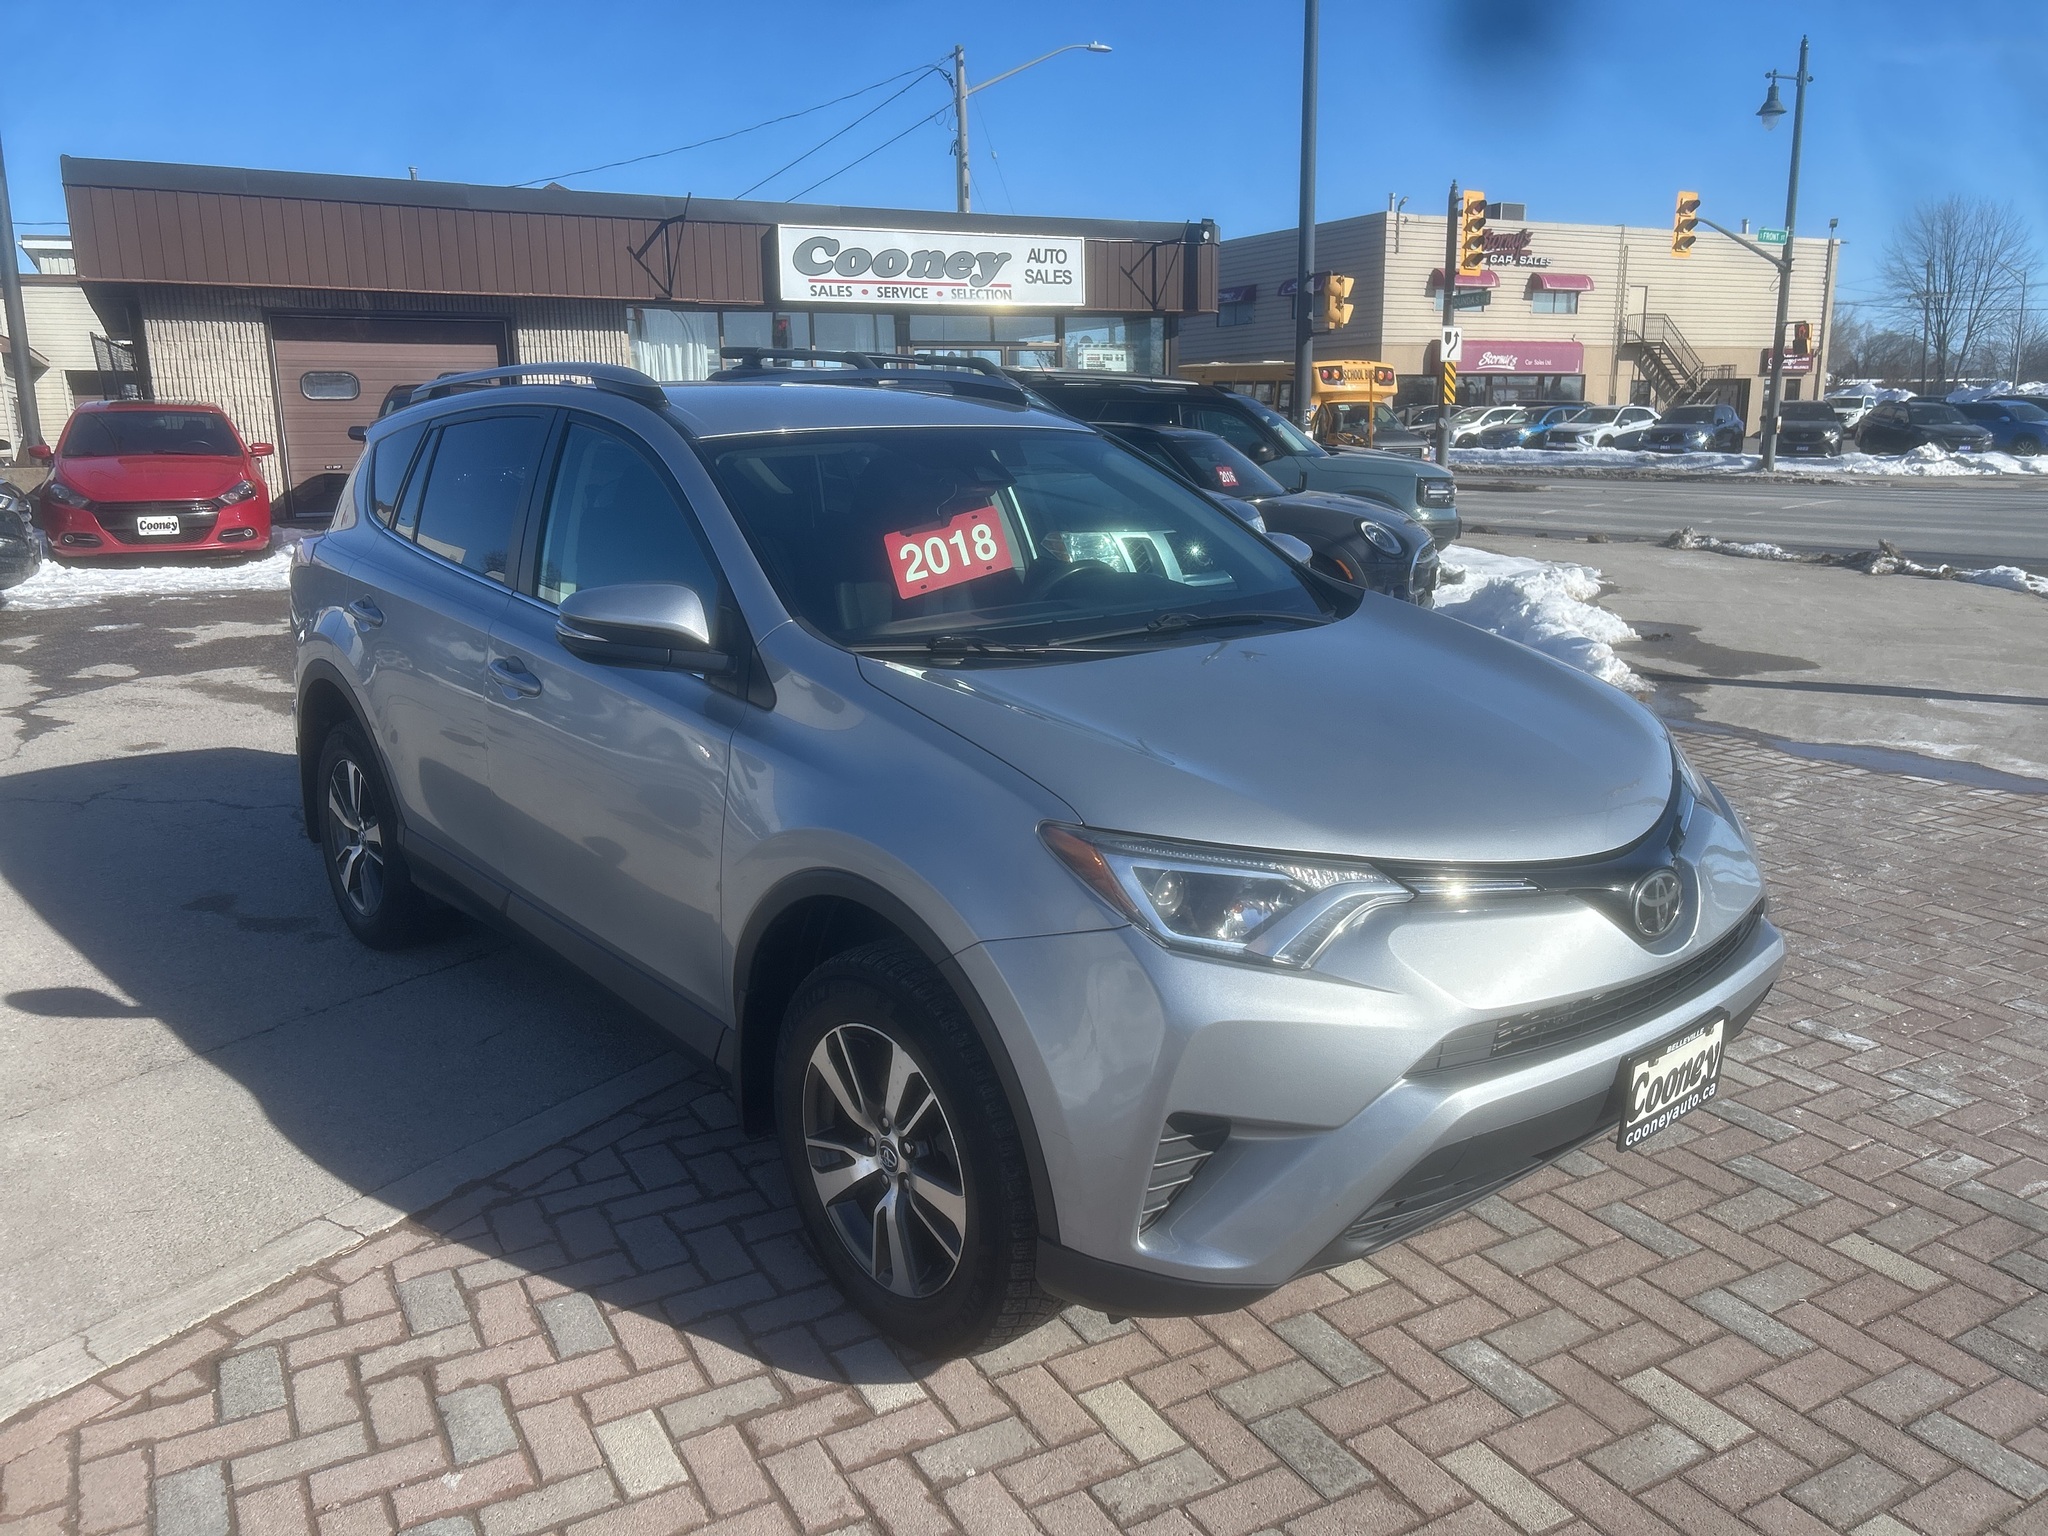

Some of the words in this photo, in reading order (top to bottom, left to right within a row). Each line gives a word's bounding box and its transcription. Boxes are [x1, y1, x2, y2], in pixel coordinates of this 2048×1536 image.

[1763, 232, 1779, 241] FRONT
[792, 236, 1012, 288] Cooney
[1027, 248, 1068, 265] AUTO
[1519, 256, 1553, 266] SALES
[1024, 269, 1073, 285] SALES
[810, 285, 853, 298] SALES
[876, 286, 929, 299] SERVICE
[951, 287, 1013, 301] SELECTION
[1453, 296, 1480, 307] DUNDAS
[1343, 369, 1364, 381] SCHOOL
[1219, 471, 1236, 484] 2016
[139, 520, 178, 532] Cooney
[899, 523, 998, 583] 2018
[1666, 1027, 1705, 1054] BELLEVILLE
[1627, 1041, 1720, 1123] Cooney
[1625, 1082, 1717, 1147] cooneyauto.ca
